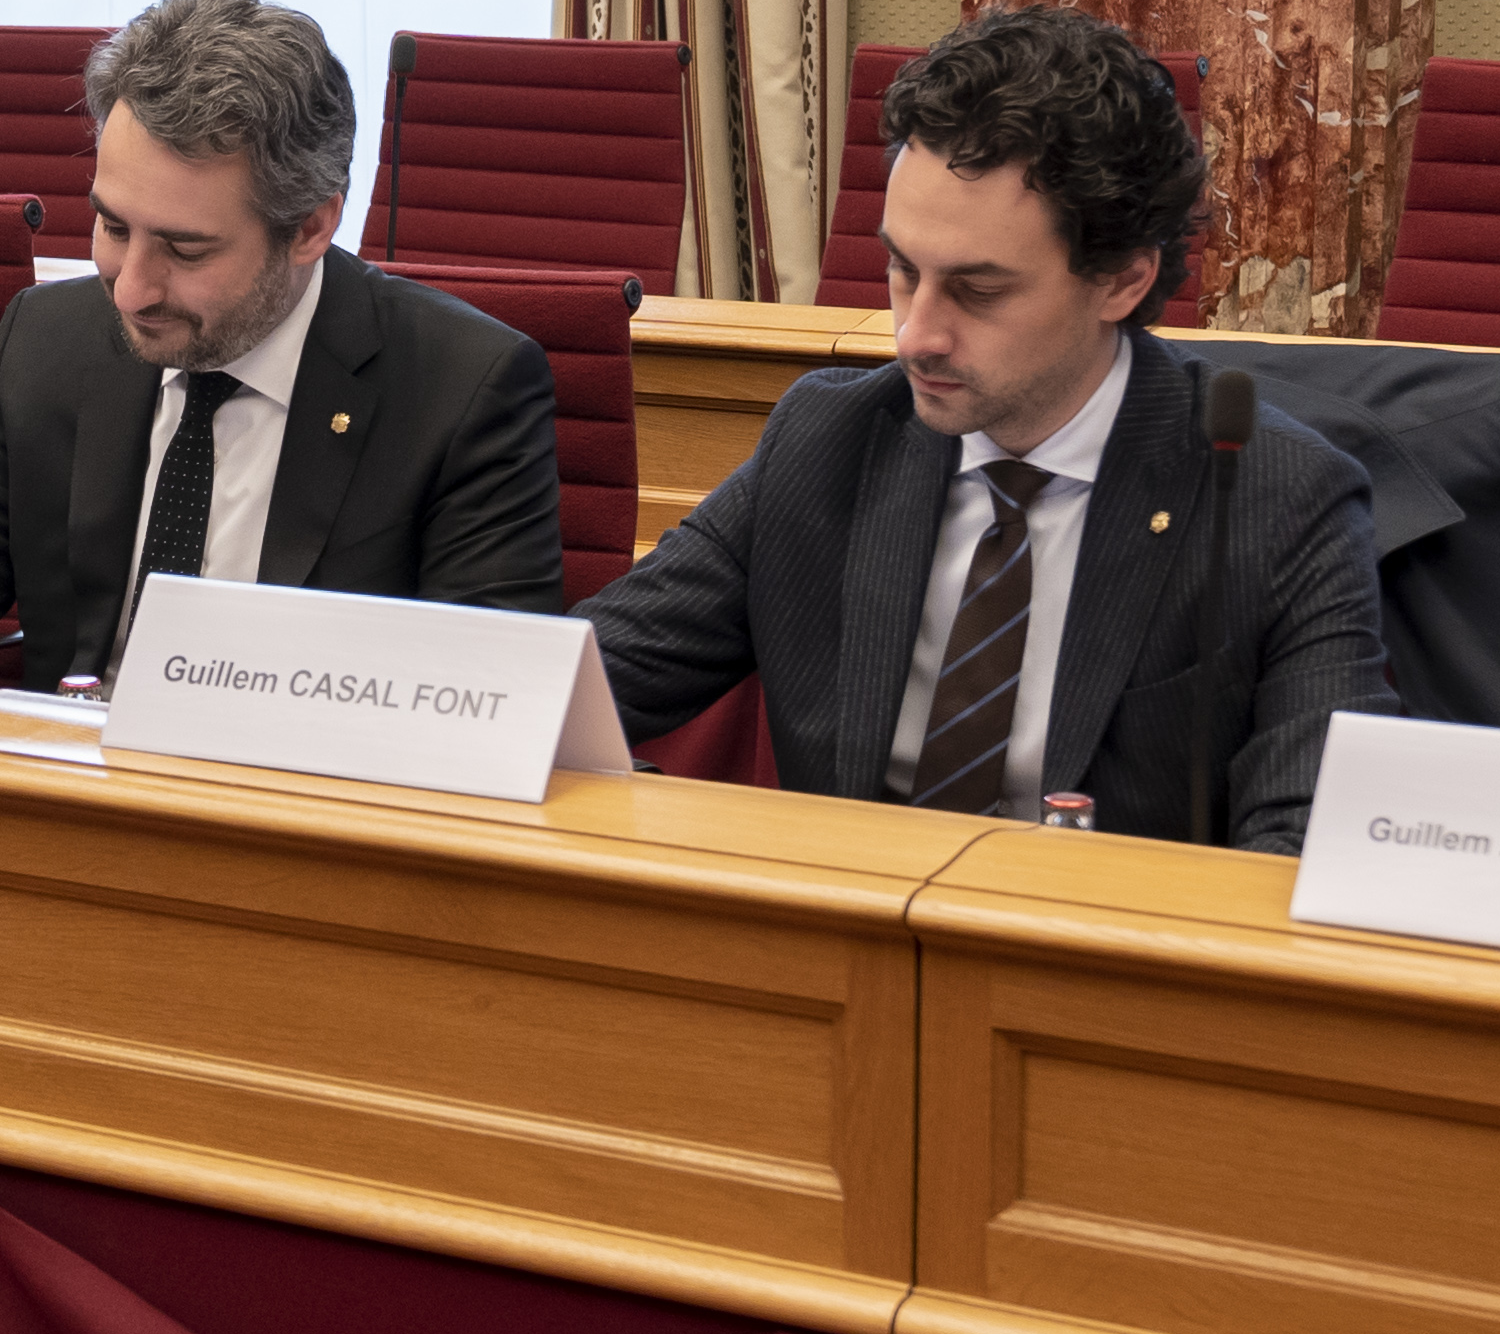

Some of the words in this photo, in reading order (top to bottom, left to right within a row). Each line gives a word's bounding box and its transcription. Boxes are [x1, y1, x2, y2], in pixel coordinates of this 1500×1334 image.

[164, 655, 278, 693] Guillem
[290, 670, 398, 708] CASAL
[412, 684, 507, 719] FONT
[1369, 817, 1490, 853] Guillem
